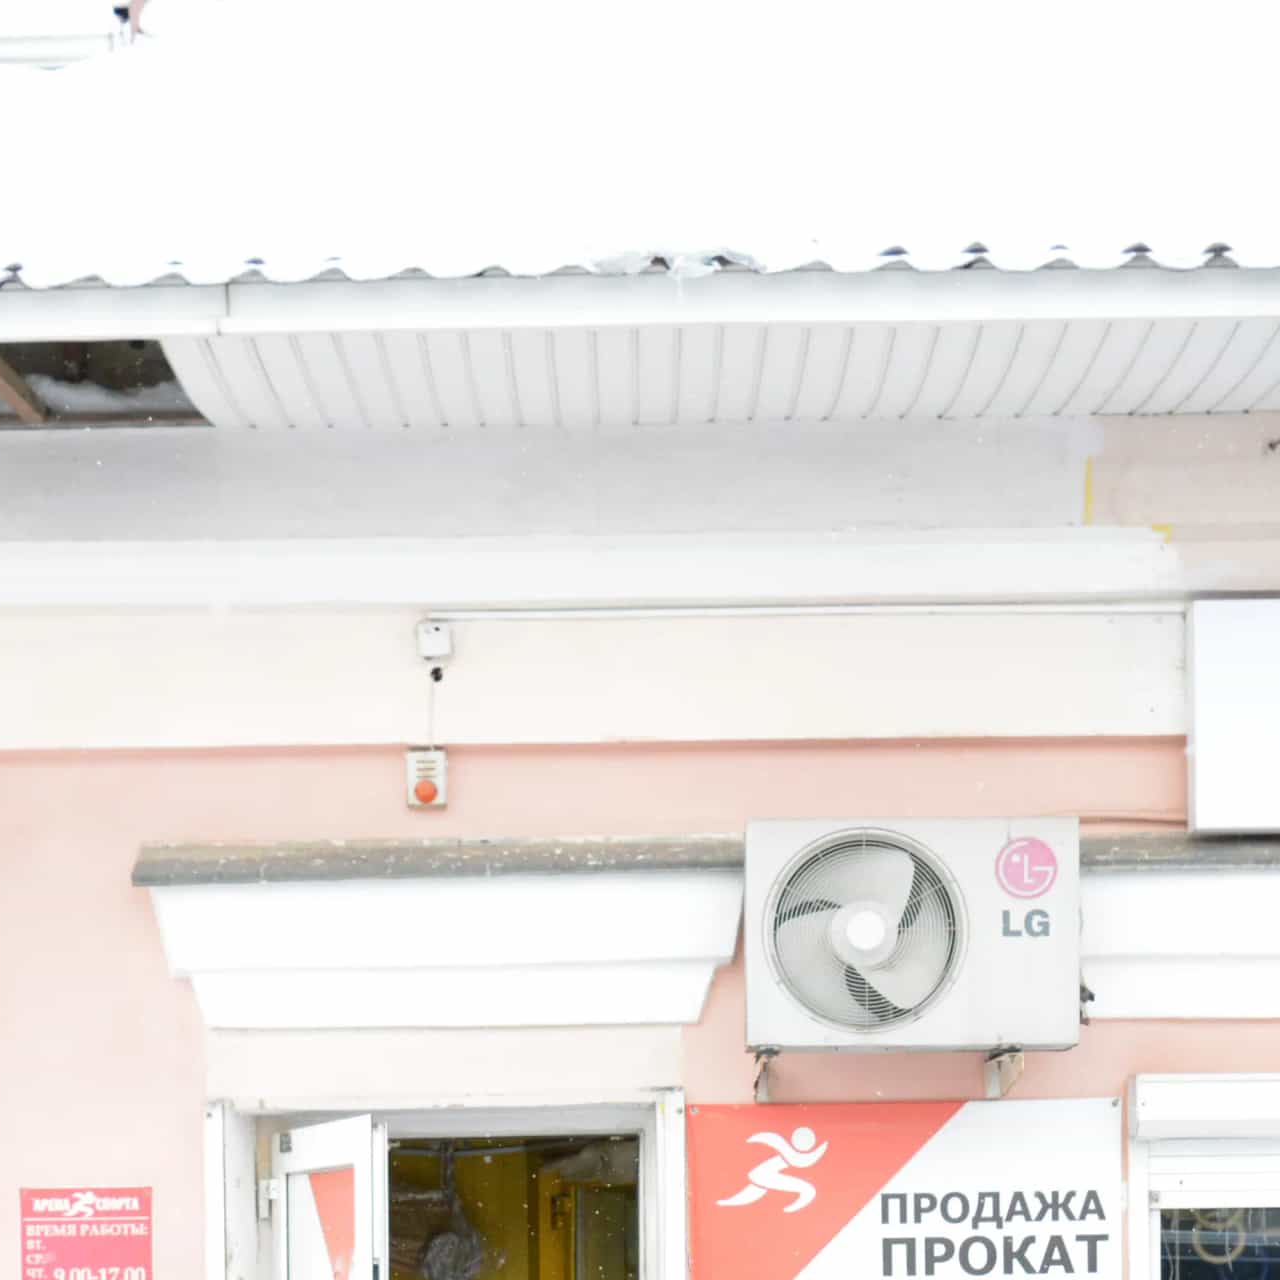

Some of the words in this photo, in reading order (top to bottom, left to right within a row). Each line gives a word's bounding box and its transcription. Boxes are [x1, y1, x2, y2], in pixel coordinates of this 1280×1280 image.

[1001, 909, 1051, 937] LG
[880, 1190, 1107, 1230] ПРОДАЖА
[26, 1224, 76, 1237] ВРЕМЯ
[881, 1234, 1110, 1277] ПРОКАТ
